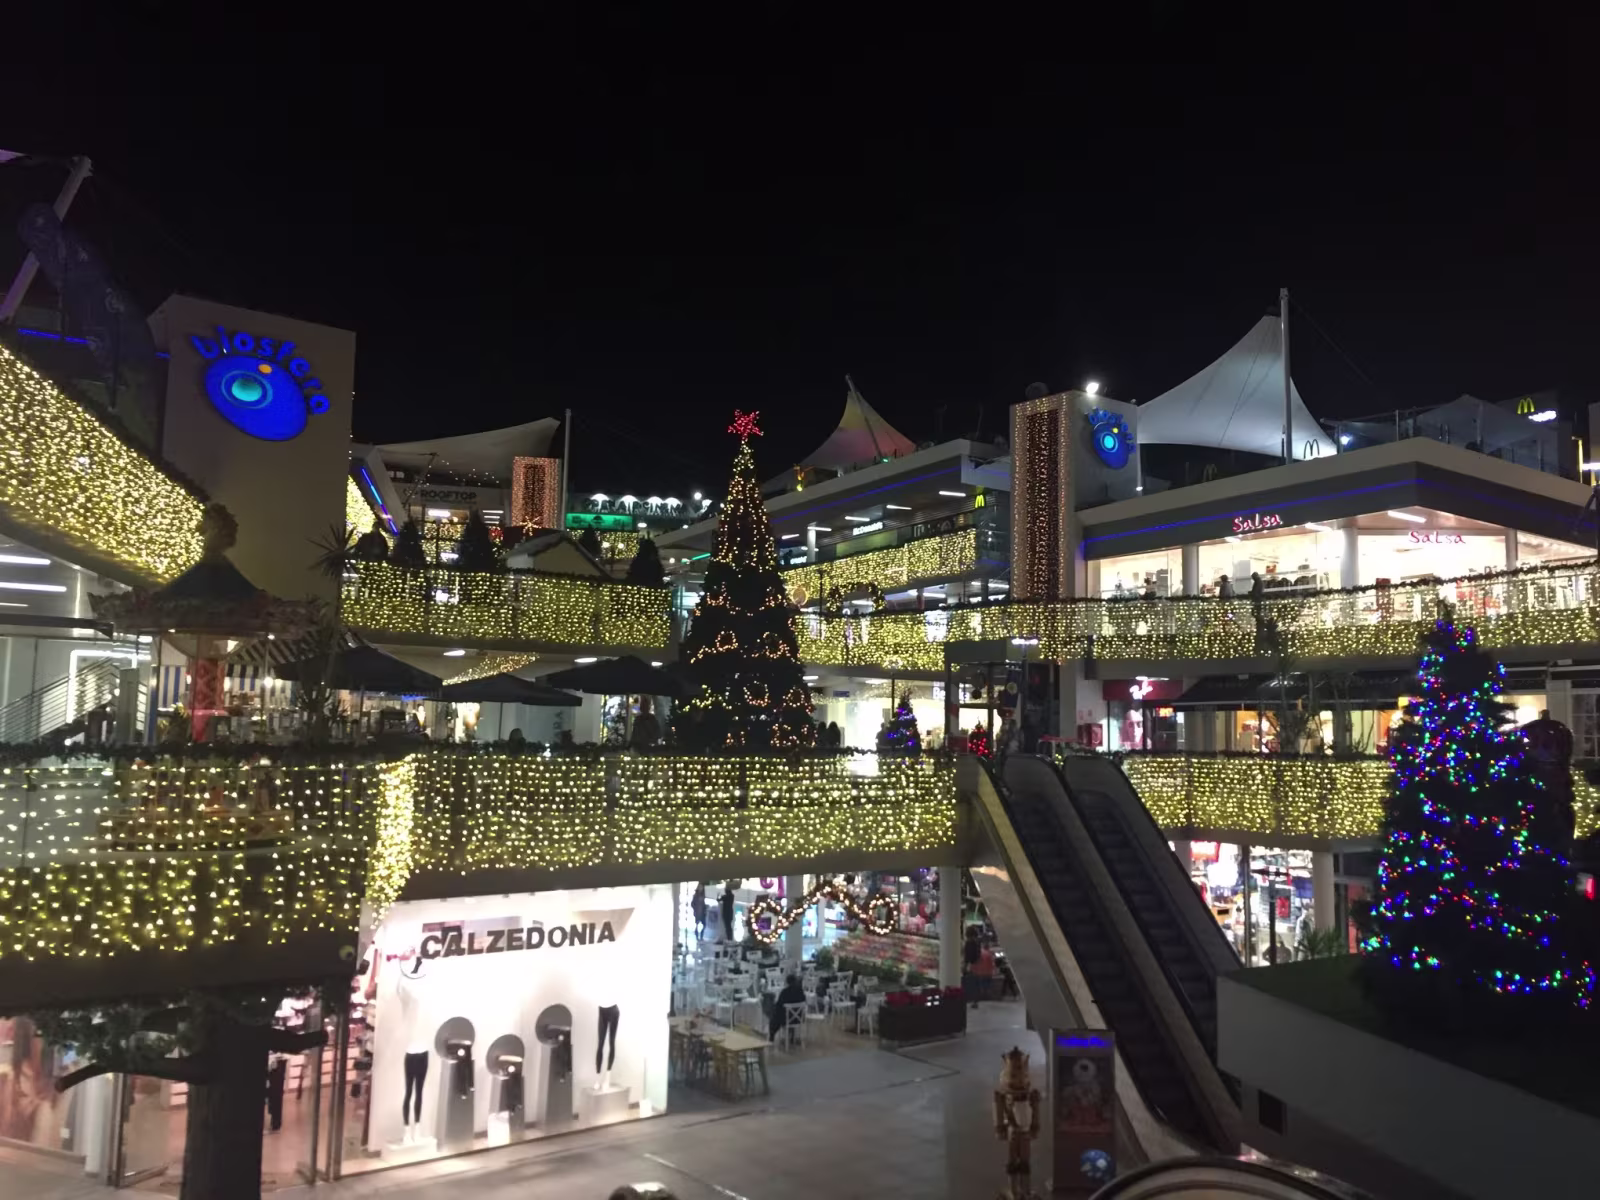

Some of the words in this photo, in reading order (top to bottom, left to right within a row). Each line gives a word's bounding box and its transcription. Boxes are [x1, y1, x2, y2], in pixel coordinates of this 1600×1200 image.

[420, 489, 477, 501] ROOFTOP
[1232, 513, 1283, 532] Salsa
[1409, 530, 1466, 544] Salsa
[420, 920, 616, 960] CALZEDONIA
